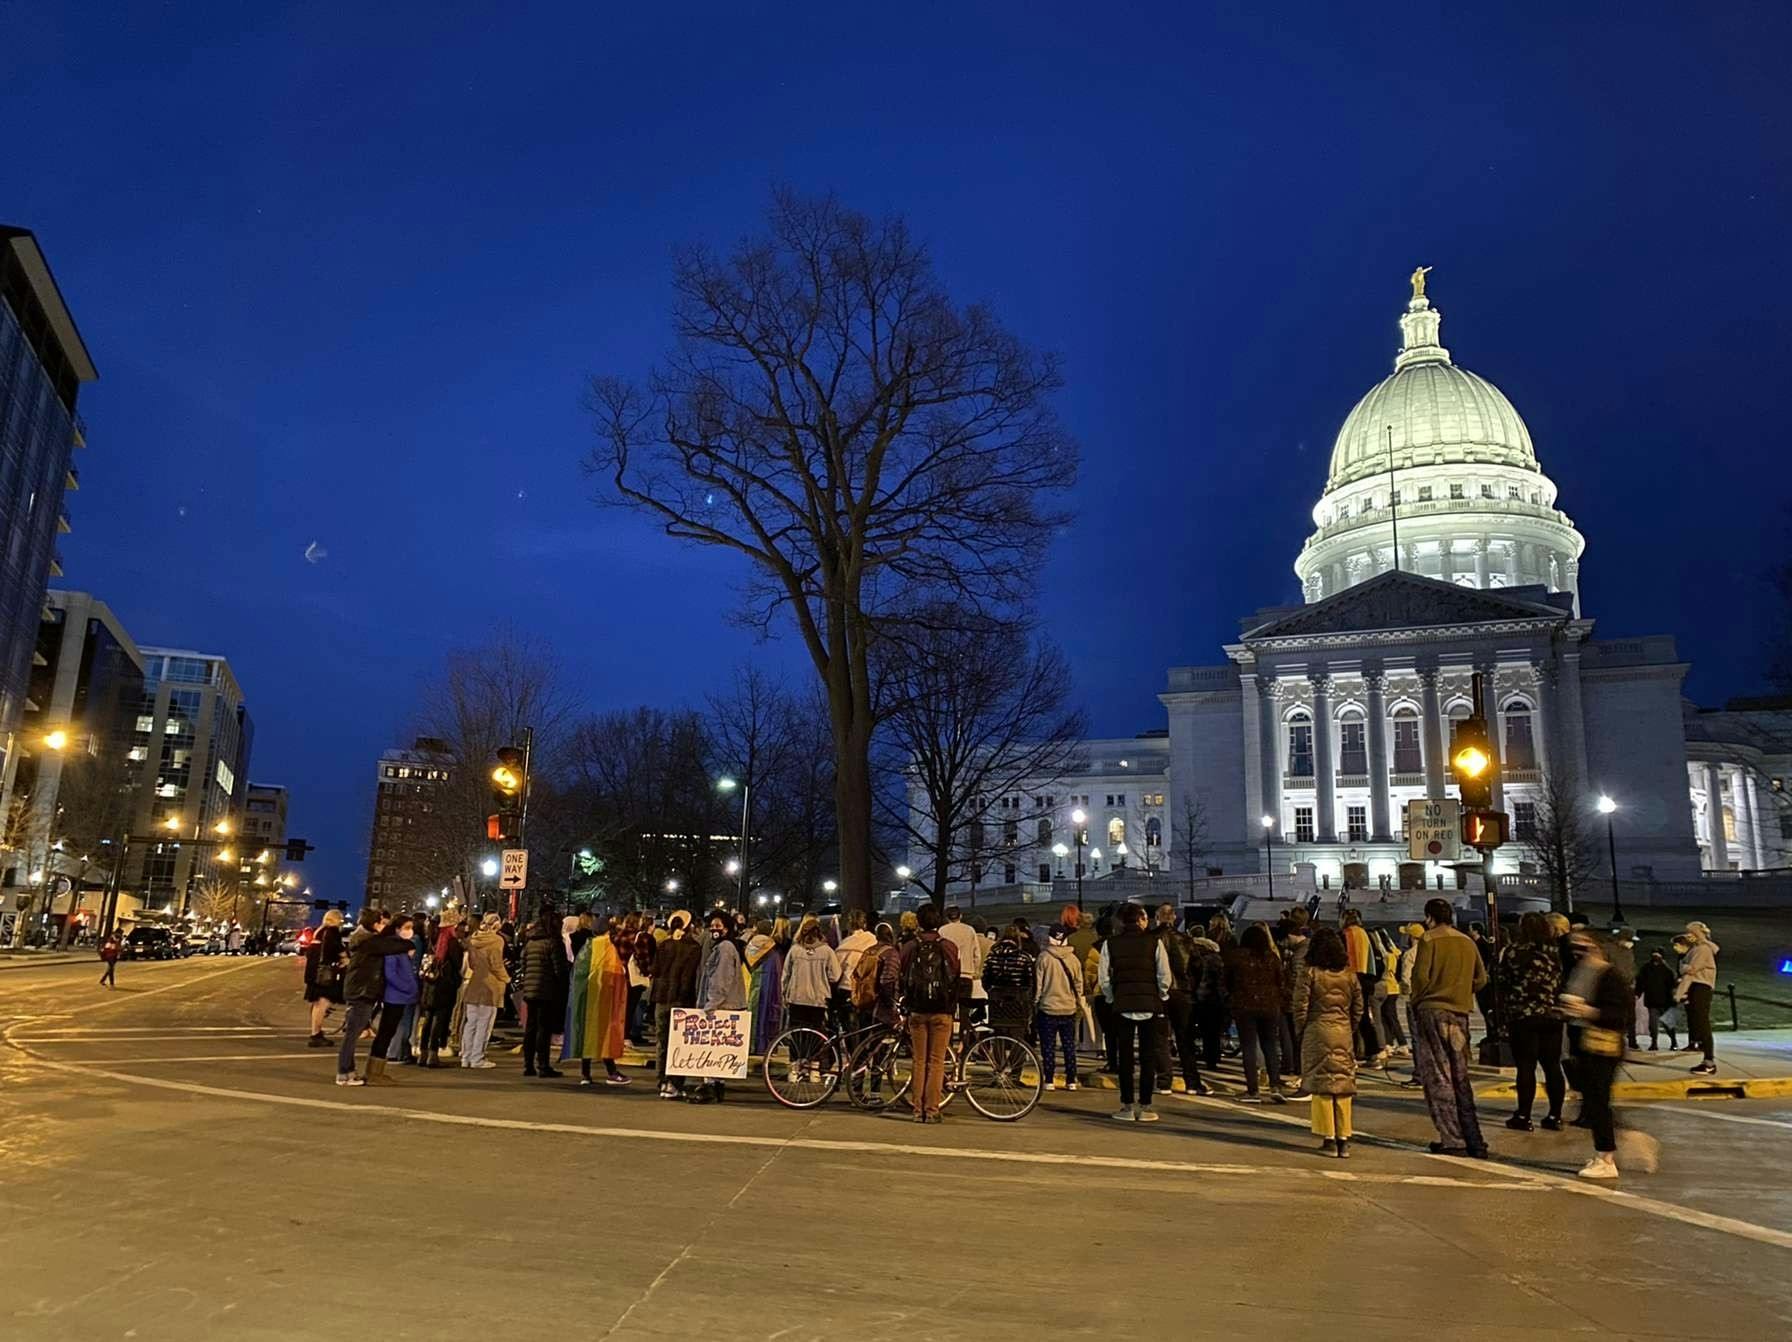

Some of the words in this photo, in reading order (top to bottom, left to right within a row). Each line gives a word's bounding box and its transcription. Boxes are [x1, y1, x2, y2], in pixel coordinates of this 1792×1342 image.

[1425, 804, 1441, 816] NO
[1422, 818, 1446, 828] TURN
[1416, 830, 1429, 840] ON
[1434, 830, 1453, 840] RED
[505, 854, 524, 863] ONE
[504, 864, 523, 873] WAY
[682, 1029, 709, 1044] THE
